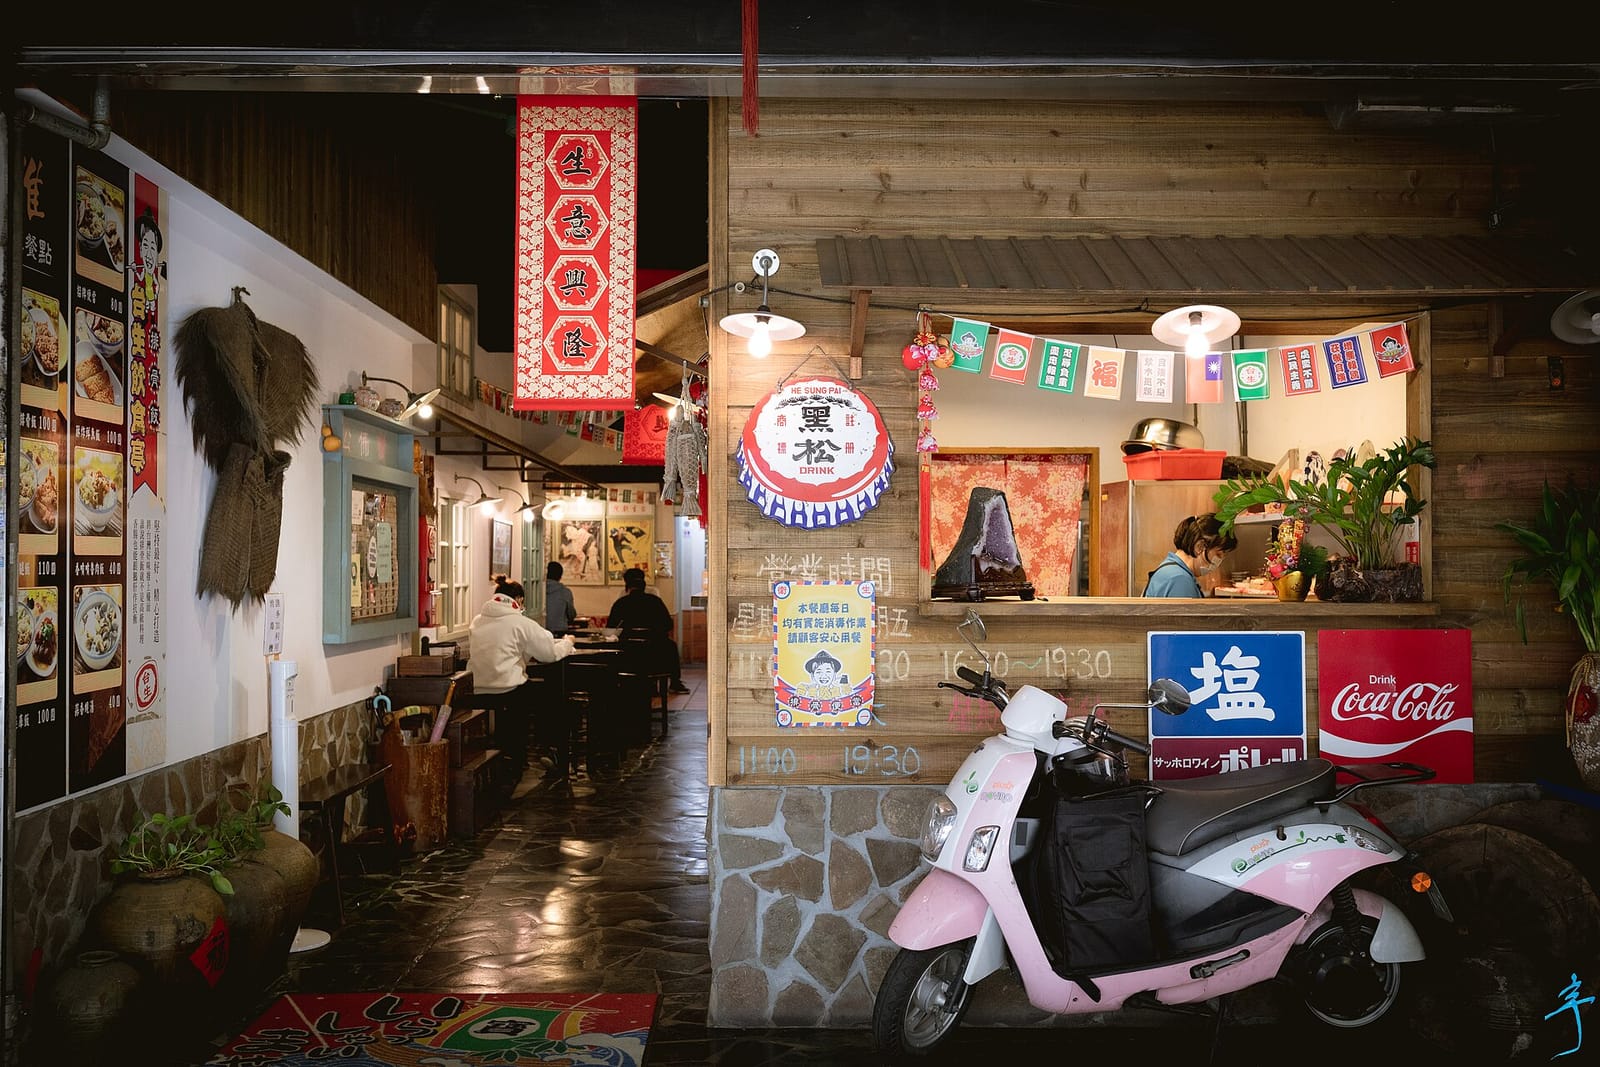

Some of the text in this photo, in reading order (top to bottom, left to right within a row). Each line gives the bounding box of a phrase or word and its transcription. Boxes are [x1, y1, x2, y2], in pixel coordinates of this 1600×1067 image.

[560, 146, 593, 360] 生意興隆
[1006, 347, 1018, 364] 台生
[1092, 360, 1117, 388] 福
[1245, 366, 1257, 382] 台生
[1287, 351, 1301, 391] 三民主義
[792, 405, 841, 465] 黑松
[799, 467, 834, 475] DRINK
[860, 585, 871, 595] 生
[798, 603, 849, 614] 本餐廳每日
[788, 632, 861, 643] 請顧客安心用餐
[142, 672, 152, 700] 台生
[1190, 645, 1276, 722] 塩
[1369, 674, 1397, 685] Drink
[1331, 682, 1460, 722] Coca-Cola
[739, 745, 921, 775] 11:00 19:30
